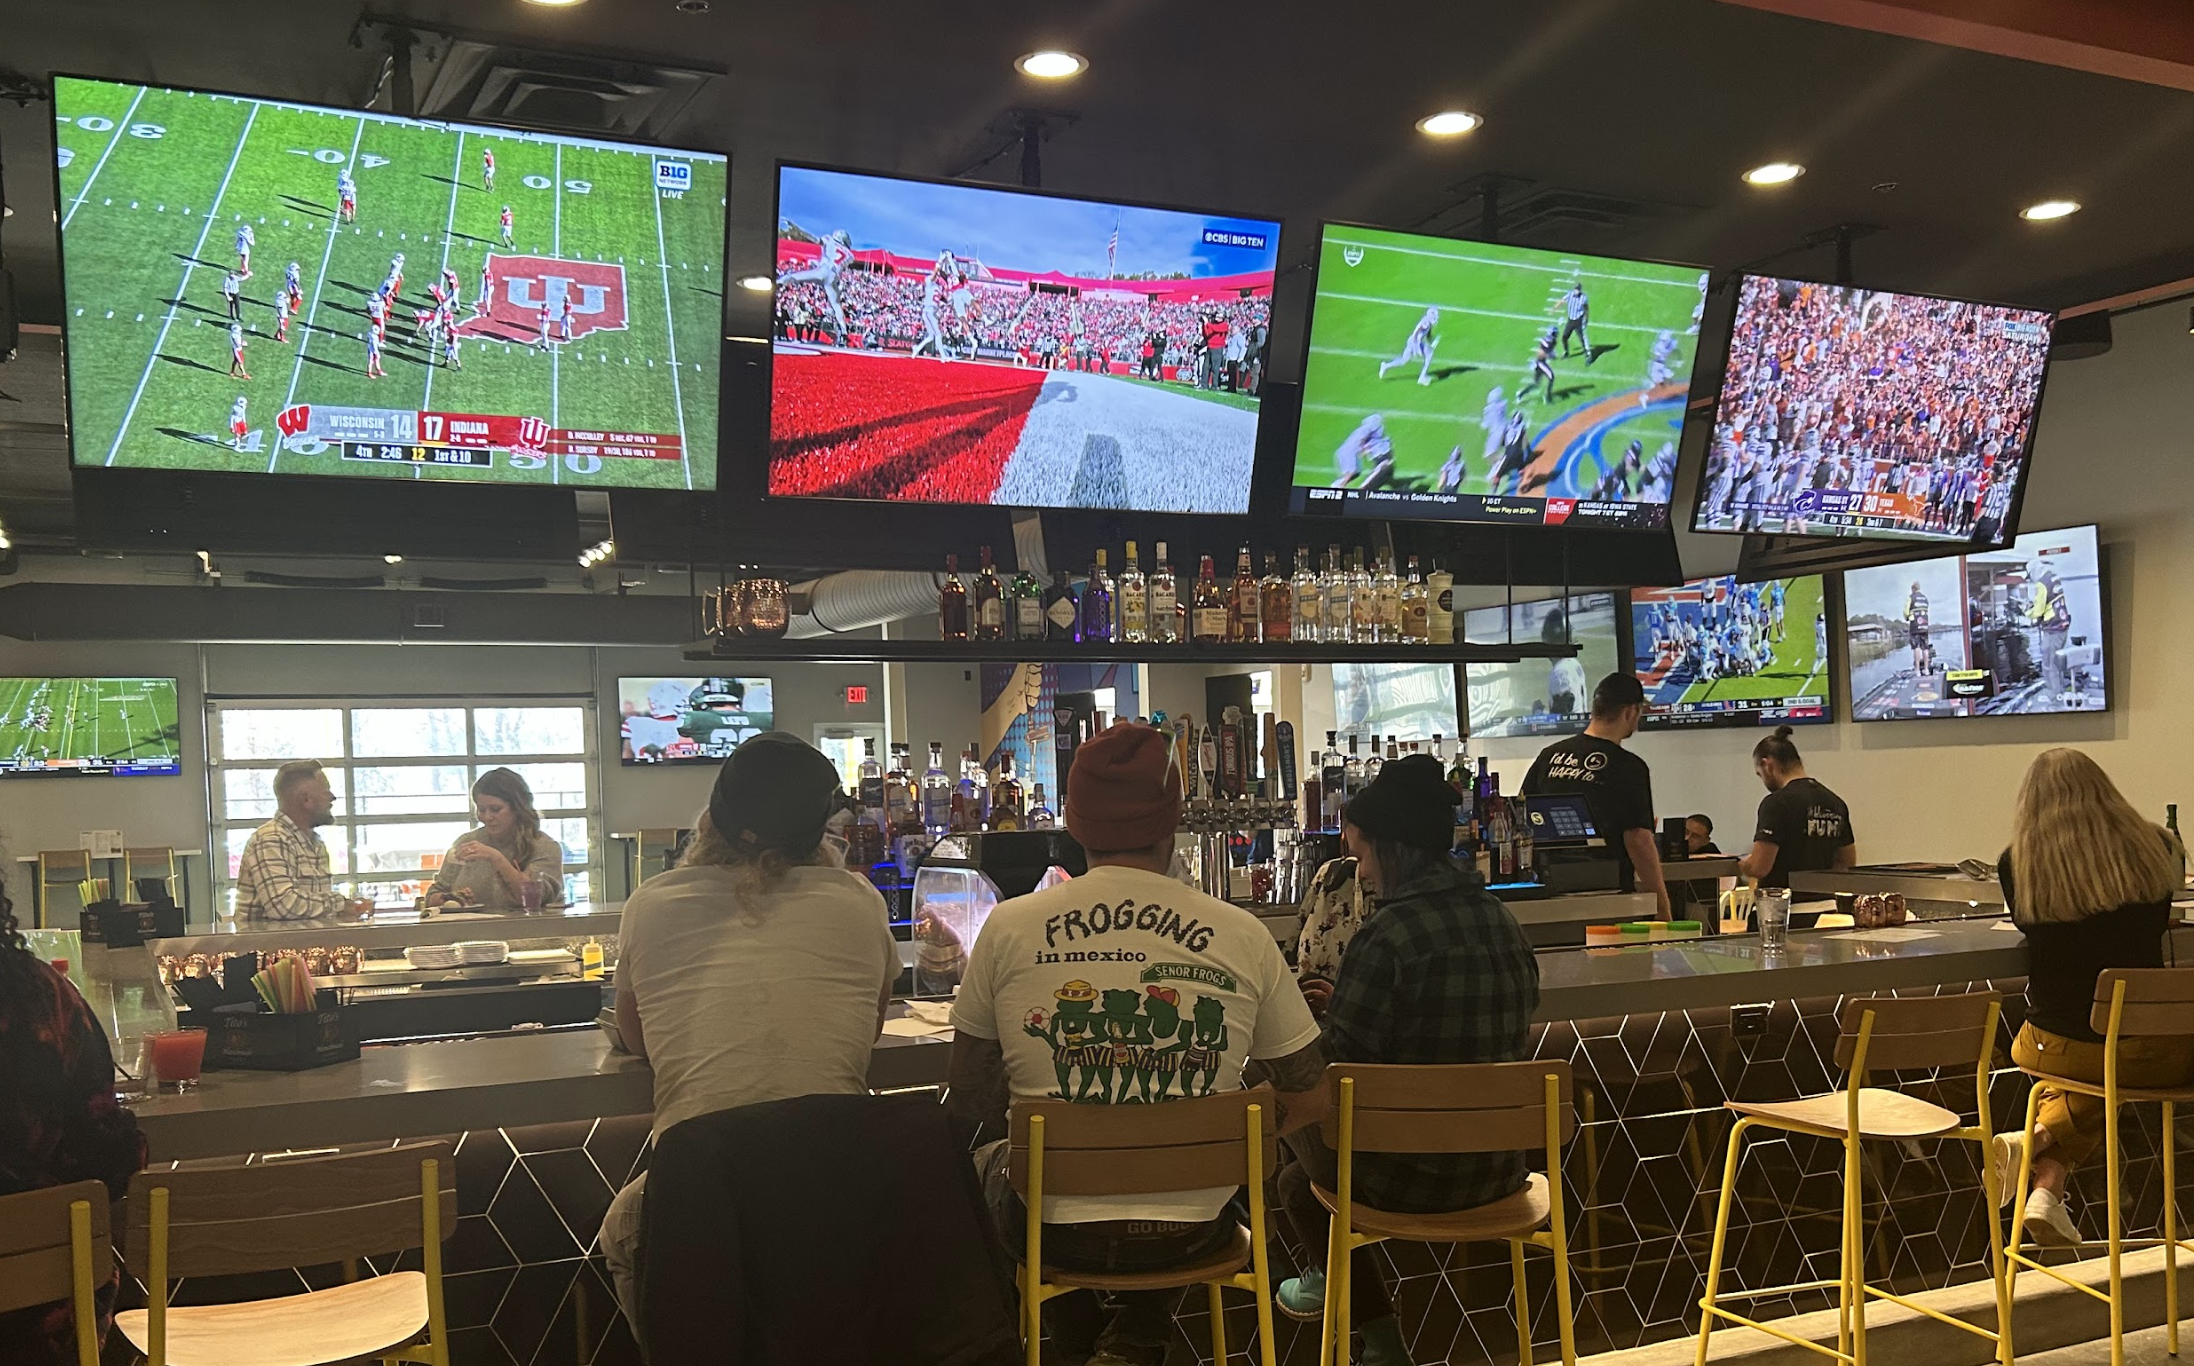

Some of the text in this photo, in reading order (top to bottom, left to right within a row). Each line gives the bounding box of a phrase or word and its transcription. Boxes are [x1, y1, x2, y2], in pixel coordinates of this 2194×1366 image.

[658, 178, 687, 186] NETWORK
[662, 189, 684, 200] LIVE
[1212, 233, 1264, 247] CBS BIG TEN
[2005, 322, 2016, 331] FOX
[2002, 331, 2039, 345] SATURDAY
[329, 414, 413, 439] WISCONSIN 14
[423, 415, 489, 441] 17 INDIANA
[381, 445, 402, 460] 2:46
[411, 447, 426, 461] 12
[1347, 491, 1360, 499] NHL
[1368, 491, 1401, 501] Avalanche
[1411, 494, 1433, 502] Golden
[1433, 495, 1457, 504] Knights
[1822, 495, 1842, 505] KANSAS
[1848, 494, 1863, 511] 27
[1863, 495, 1879, 513] 30
[1880, 498, 1894, 507] TEXAS
[1501, 507, 1513, 515] Play
[1520, 507, 1537, 515] ESPN+
[1548, 504, 1571, 512] COLLEGE
[1609, 503, 1622, 511] IOWA
[848, 687, 867, 702] EXIT
[1683, 704, 1693, 712] 28
[1738, 700, 1748, 709] 31
[1226, 735, 1236, 775] FURIOUS IPA
[1564, 753, 1579, 767] be
[1547, 766, 1585, 780] HAPPY
[1045, 898, 1215, 953] FROGGING
[1035, 948, 1147, 964] in mexico
[1154, 965, 1227, 987] SENOR FROGS
[224, 1017, 247, 1028] Tito's
[317, 1012, 340, 1025] Tito's
[1127, 1221, 1153, 1234] GO
